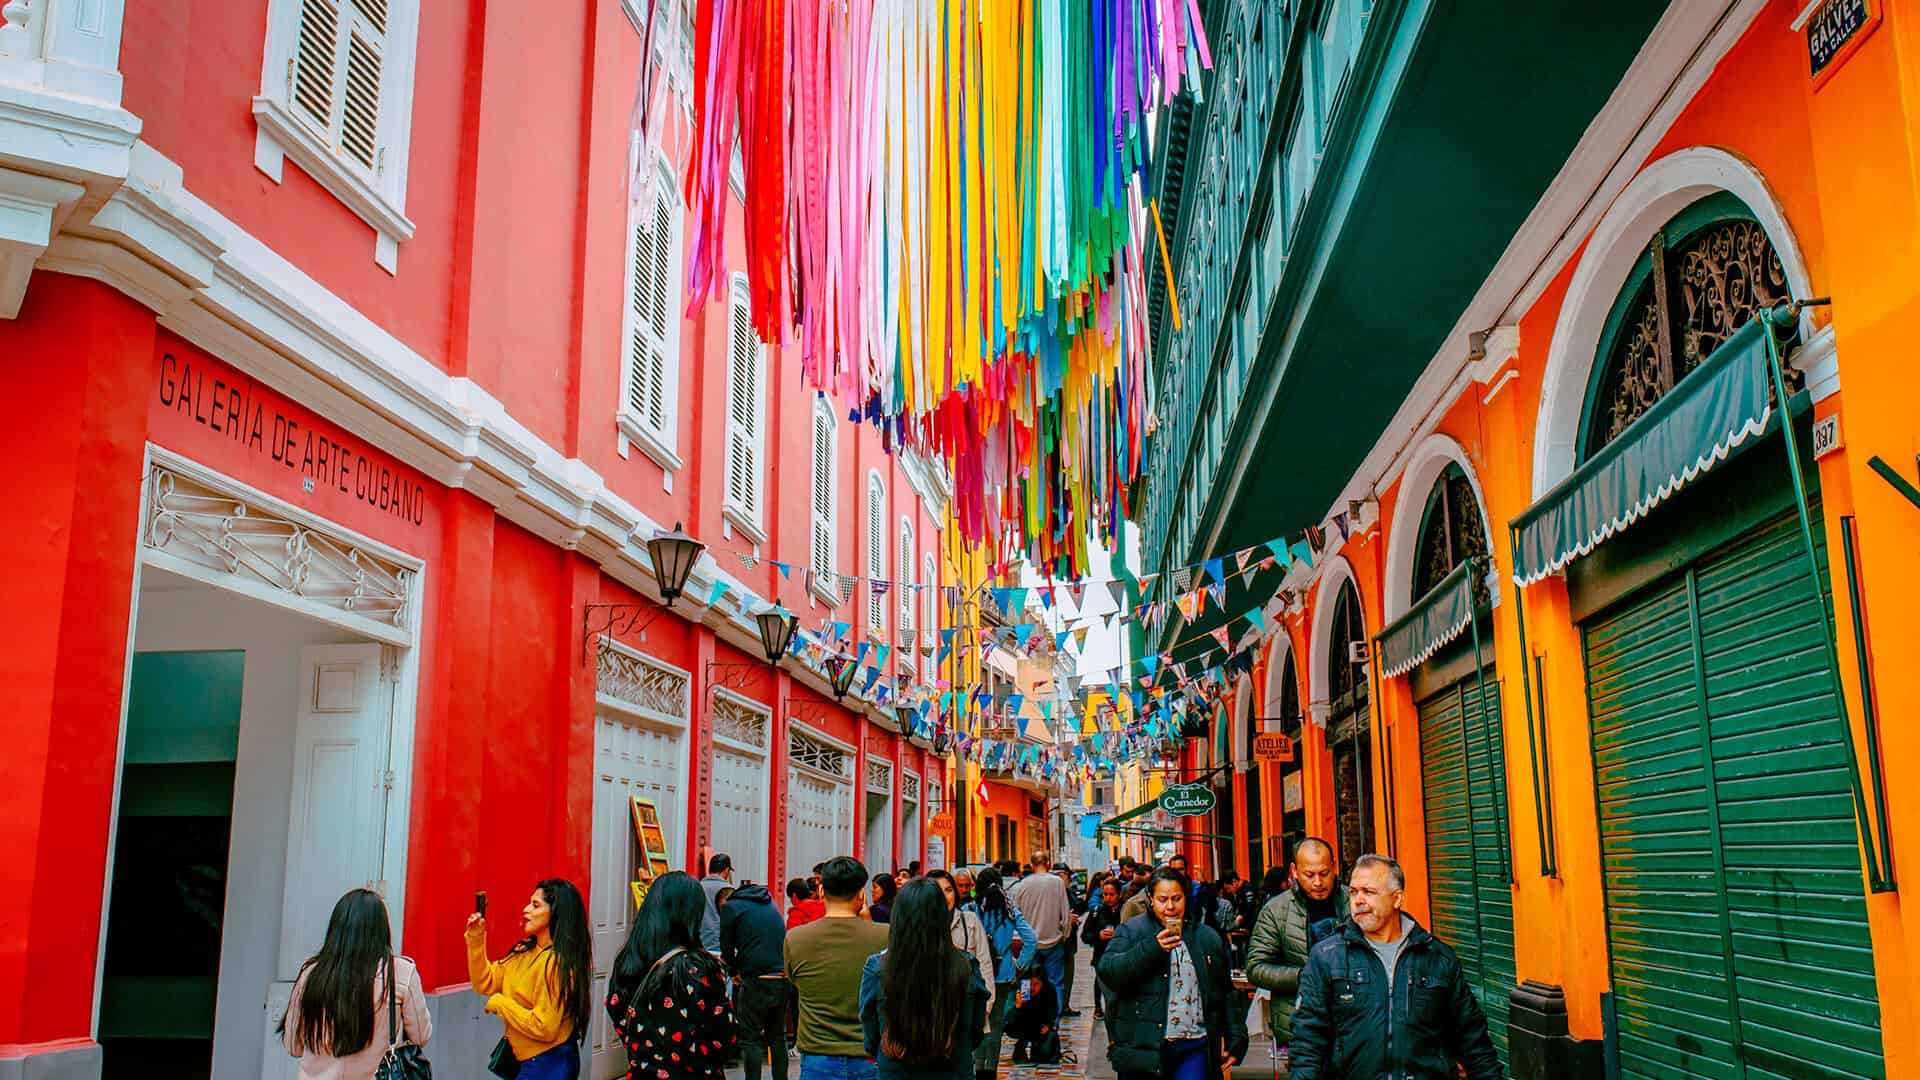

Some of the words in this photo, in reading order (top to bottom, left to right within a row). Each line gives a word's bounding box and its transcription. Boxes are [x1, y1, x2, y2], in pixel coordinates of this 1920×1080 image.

[1830, 15, 1856, 51] CALLE
[1815, 422, 1834, 451] 397
[271, 413, 298, 468] DE
[302, 431, 350, 493] ARTE
[355, 456, 424, 527] CUBANO
[1256, 738, 1289, 750] ATELIER
[1164, 795, 1209, 810] Comedor
